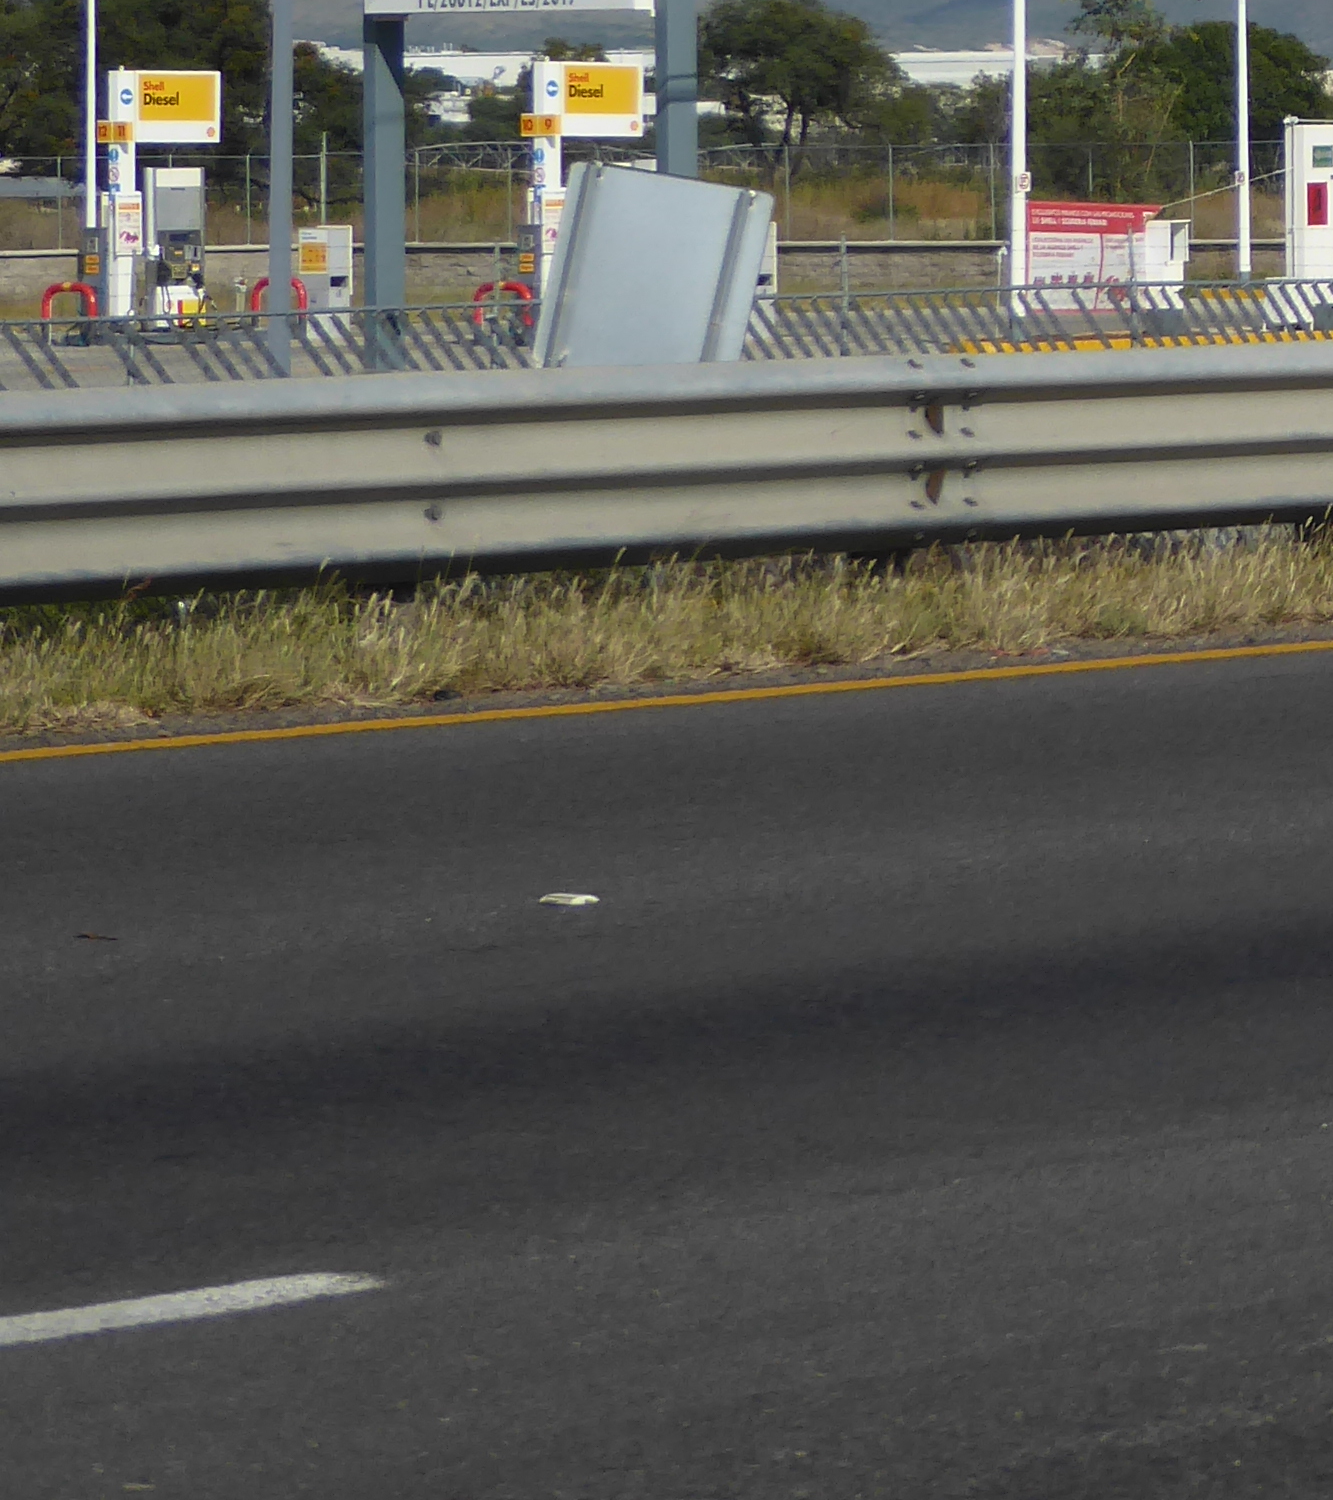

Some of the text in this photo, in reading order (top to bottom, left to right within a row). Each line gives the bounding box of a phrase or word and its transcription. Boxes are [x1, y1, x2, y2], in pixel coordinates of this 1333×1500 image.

[143, 81, 165, 92] Shell
[568, 84, 604, 99] Diesel
[143, 92, 180, 106] Diesel
